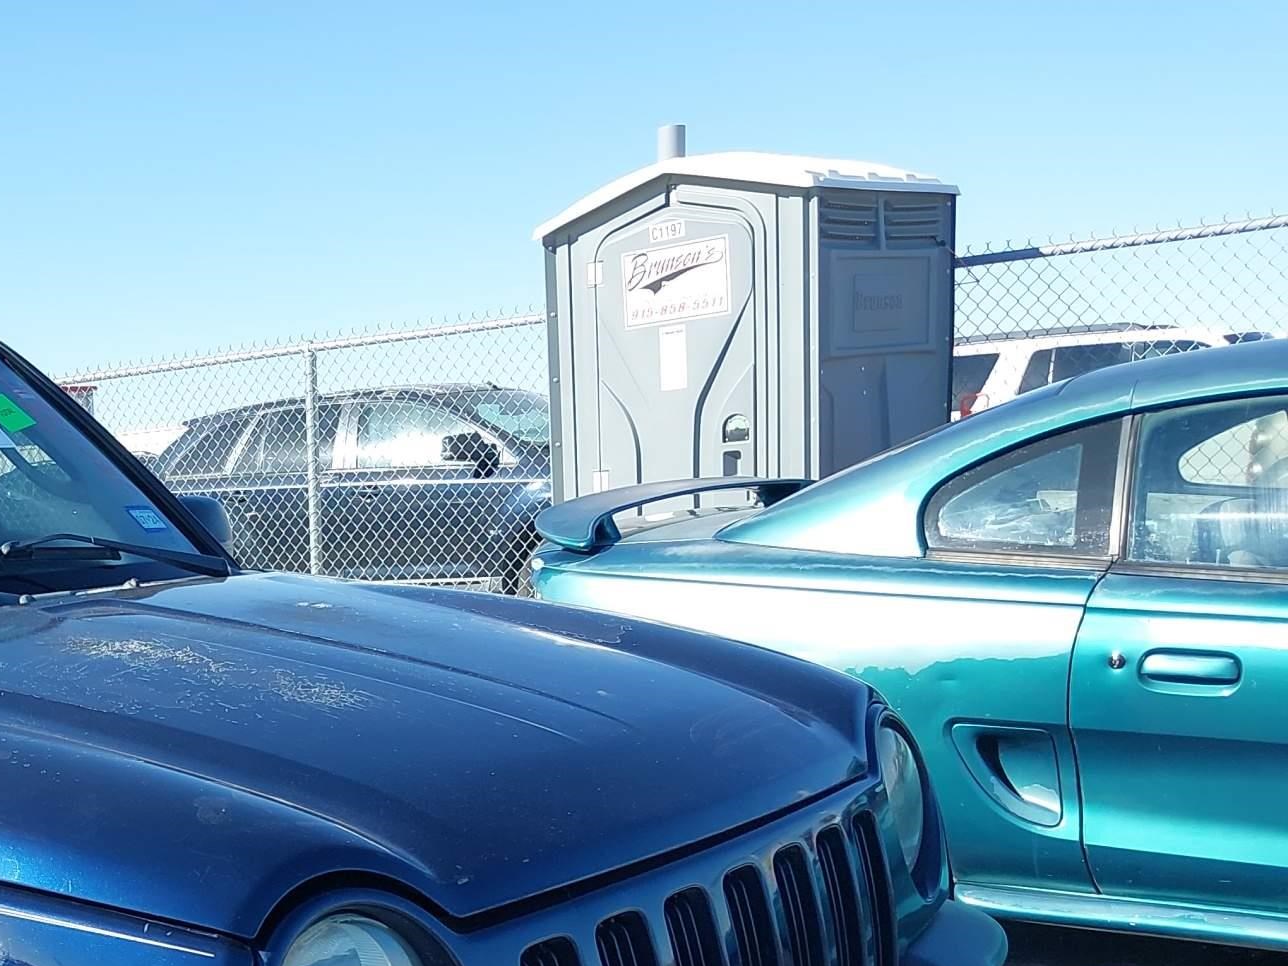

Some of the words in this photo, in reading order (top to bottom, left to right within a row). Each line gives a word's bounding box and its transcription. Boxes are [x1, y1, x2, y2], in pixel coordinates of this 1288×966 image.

[651, 222, 683, 241] C1197
[627, 244, 724, 292] Brunson's
[631, 296, 724, 321] 915-858-5511
